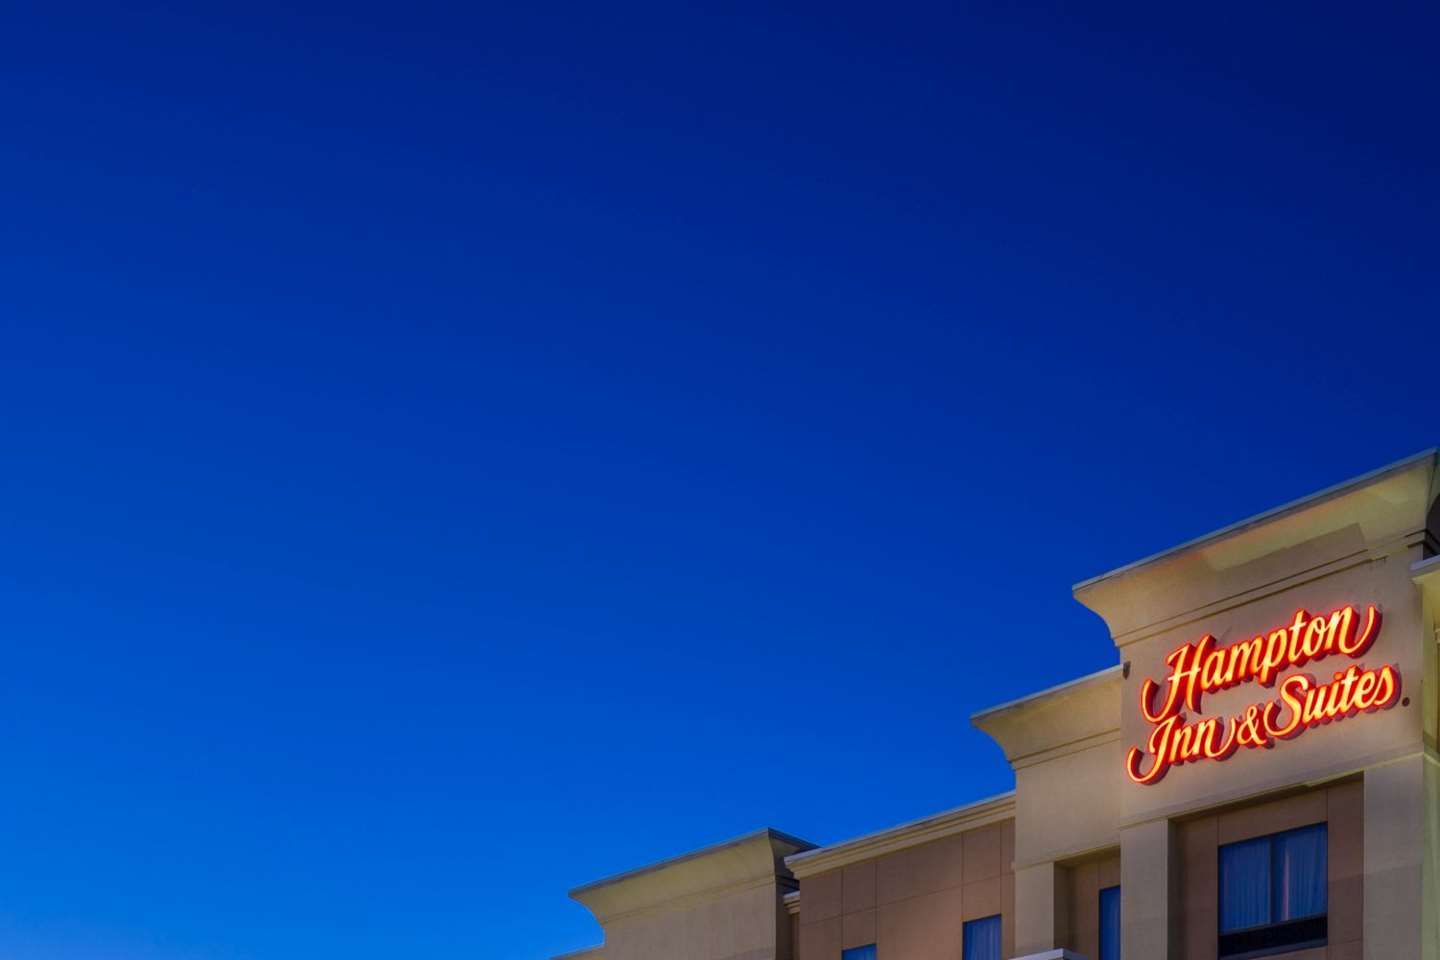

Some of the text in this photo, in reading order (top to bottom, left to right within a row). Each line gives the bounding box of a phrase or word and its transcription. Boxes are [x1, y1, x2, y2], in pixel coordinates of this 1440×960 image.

[1141, 603, 1382, 723] Hampton
[1127, 665, 1400, 783] Inn & Suites
